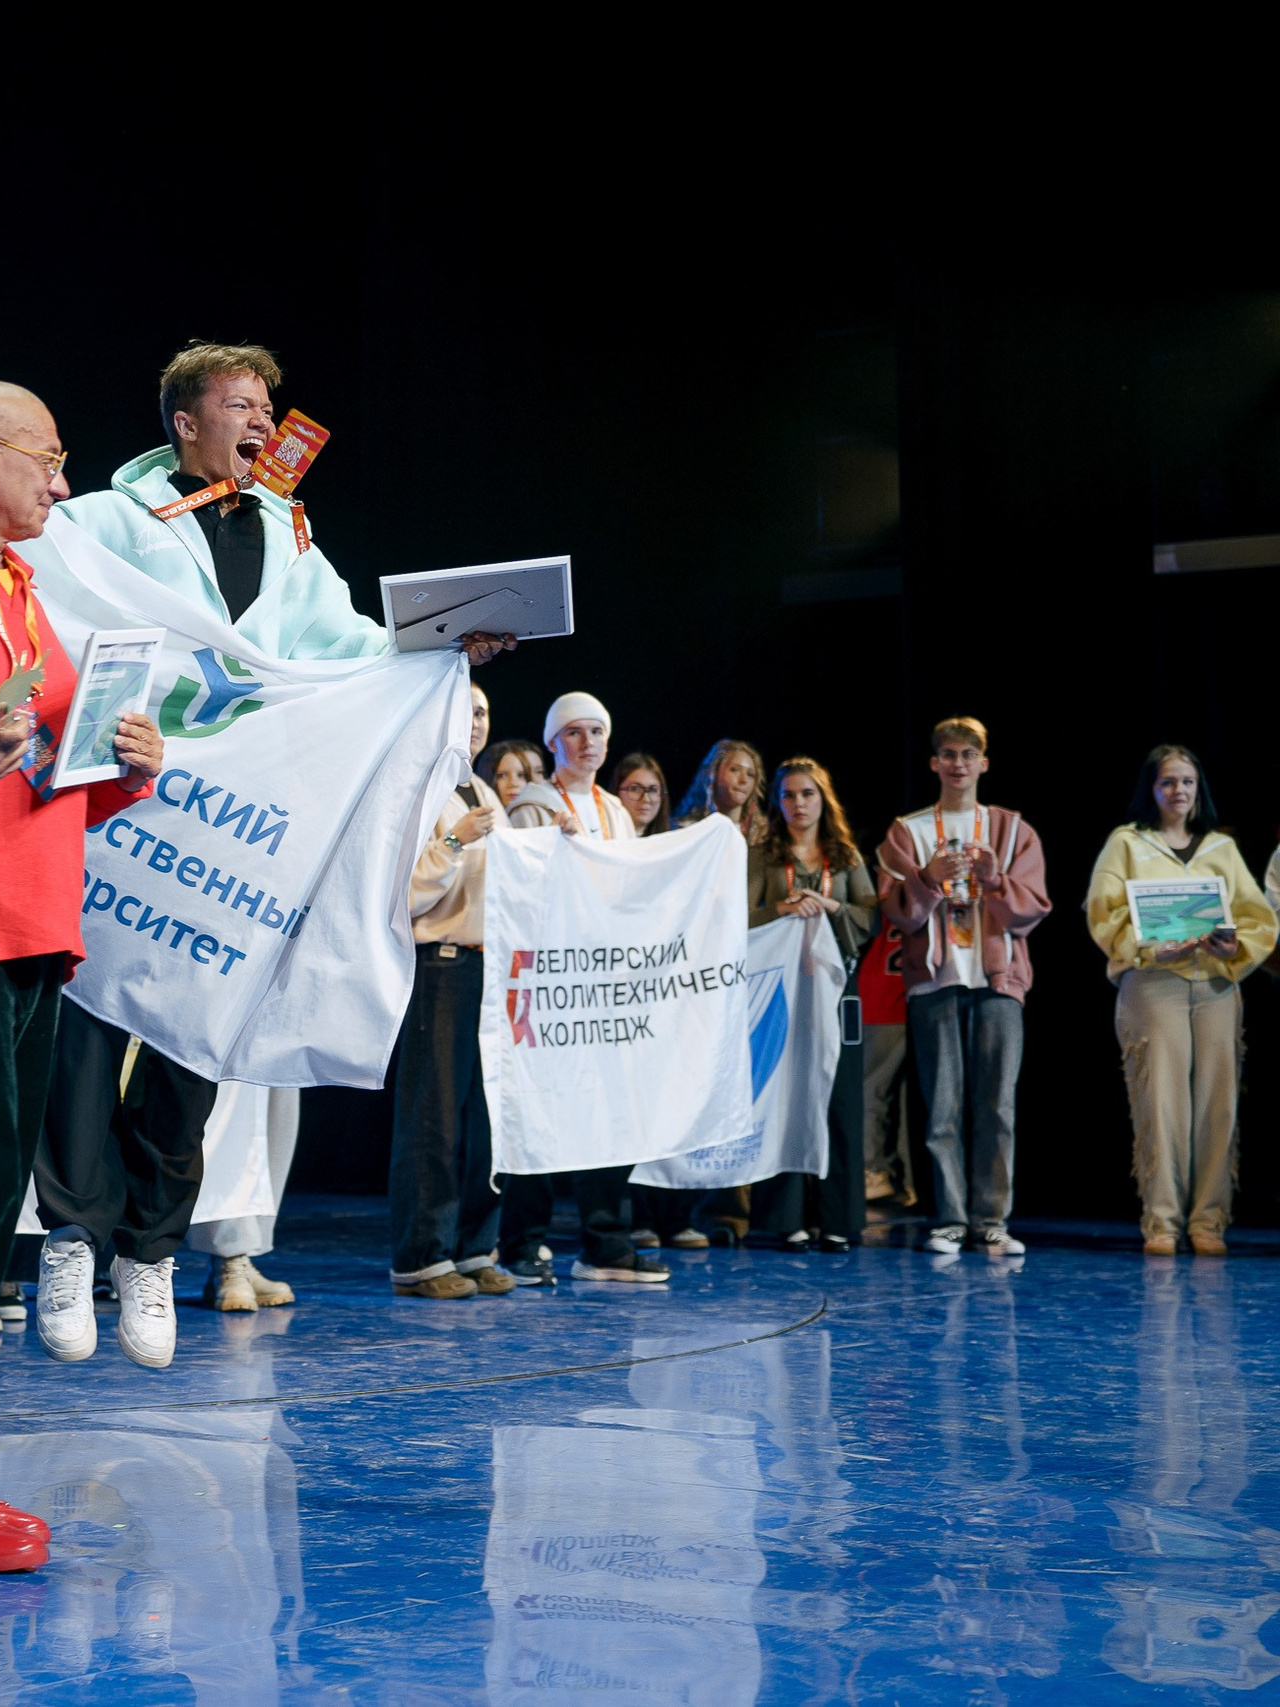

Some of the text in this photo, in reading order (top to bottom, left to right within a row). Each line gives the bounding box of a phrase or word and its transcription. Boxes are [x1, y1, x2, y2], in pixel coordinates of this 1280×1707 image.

[156, 768, 290, 857] СКИЙ
[86, 818, 310, 939] ственны
[83, 868, 247, 976] рситет
[536, 934, 688, 974] БЕЛОЯРСКИЙ
[536, 959, 747, 1011] ПОЛИТЕХНИЧЕСК
[539, 1015, 655, 1047] КОЛЛЕДЖ
